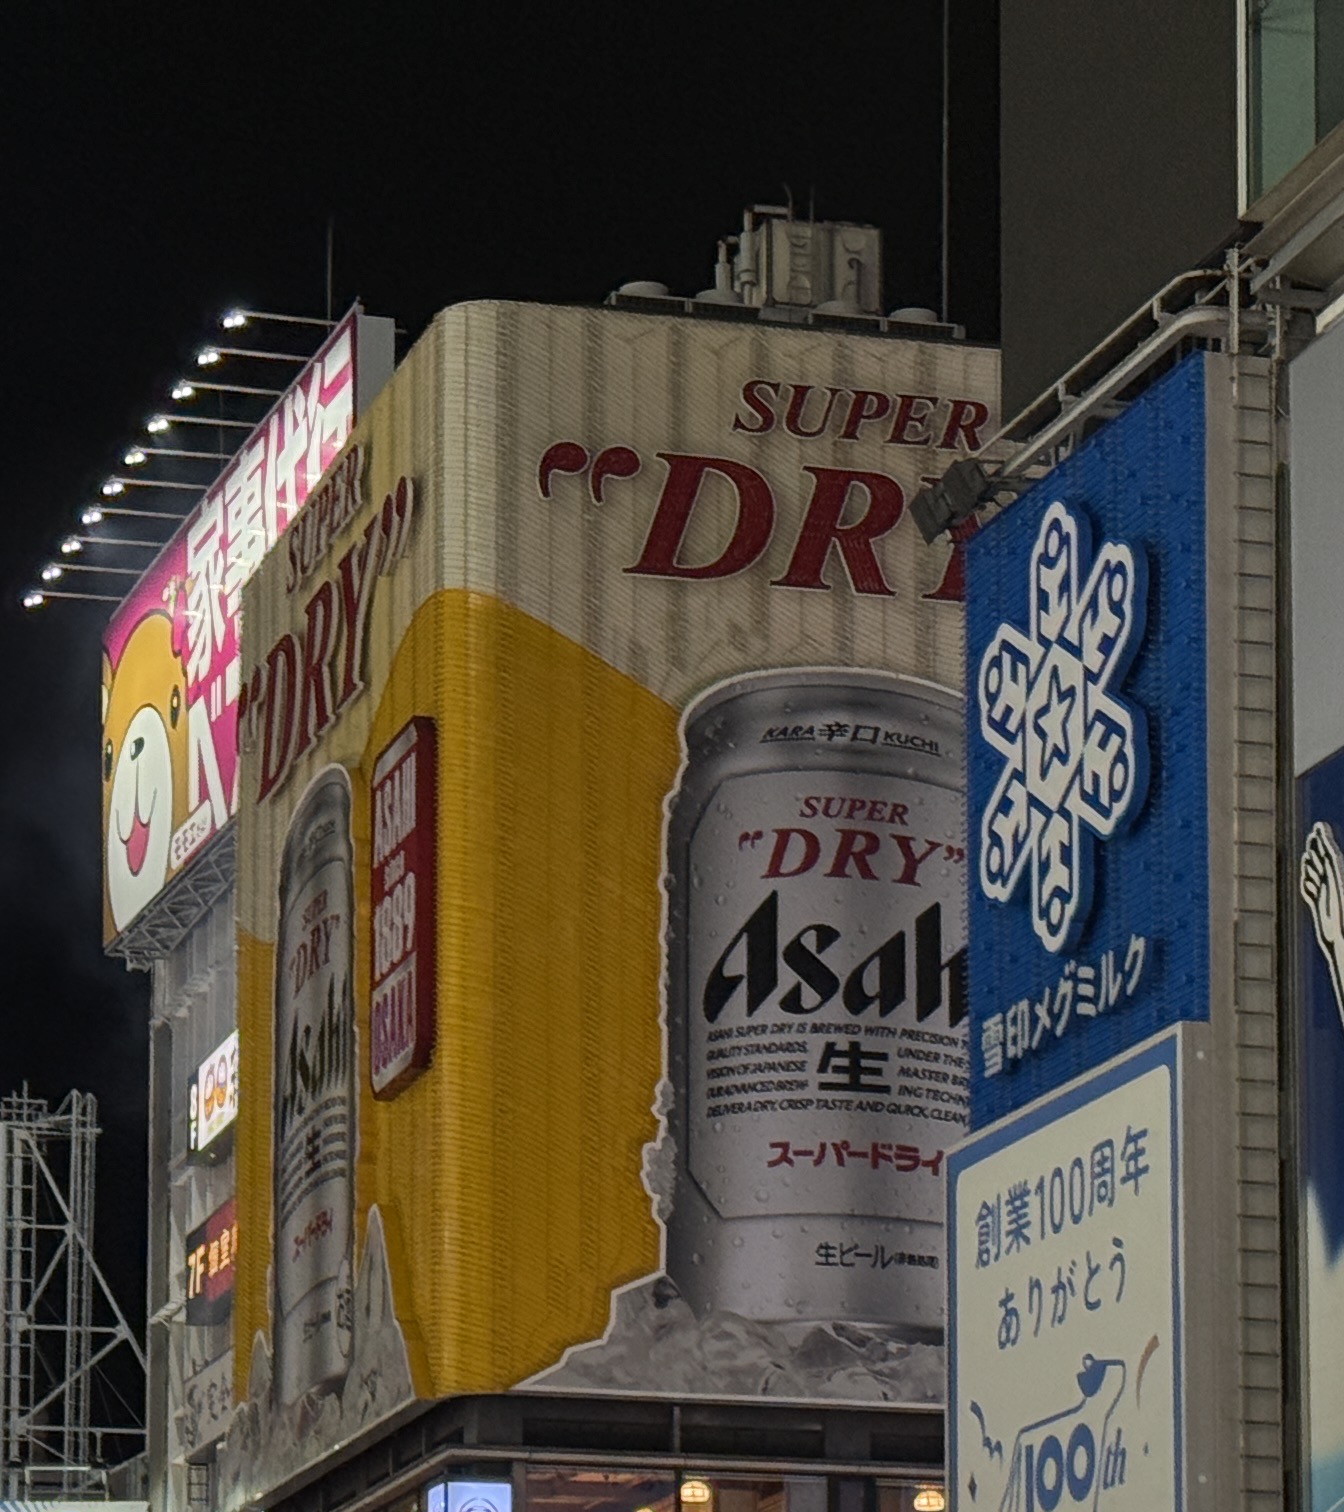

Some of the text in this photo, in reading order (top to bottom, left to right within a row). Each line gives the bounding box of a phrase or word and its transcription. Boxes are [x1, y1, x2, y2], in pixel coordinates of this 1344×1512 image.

[732, 379, 989, 452] SUPER
[882, 732, 940, 752] KUCHI
[799, 796, 910, 826] SUPER
[703, 889, 970, 1028] Asah
[810, 1023, 861, 1036] BREWED
[864, 1026, 897, 1038] WITH
[981, 934, 1147, 1078] 雪印メグミルク
[816, 1041, 892, 1095] 生
[856, 1100, 885, 1113] AND
[767, 1140, 944, 1177] スーパードライ
[975, 1124, 1150, 1269] 創業100周年
[998, 1236, 1127, 1350] ありがとう
